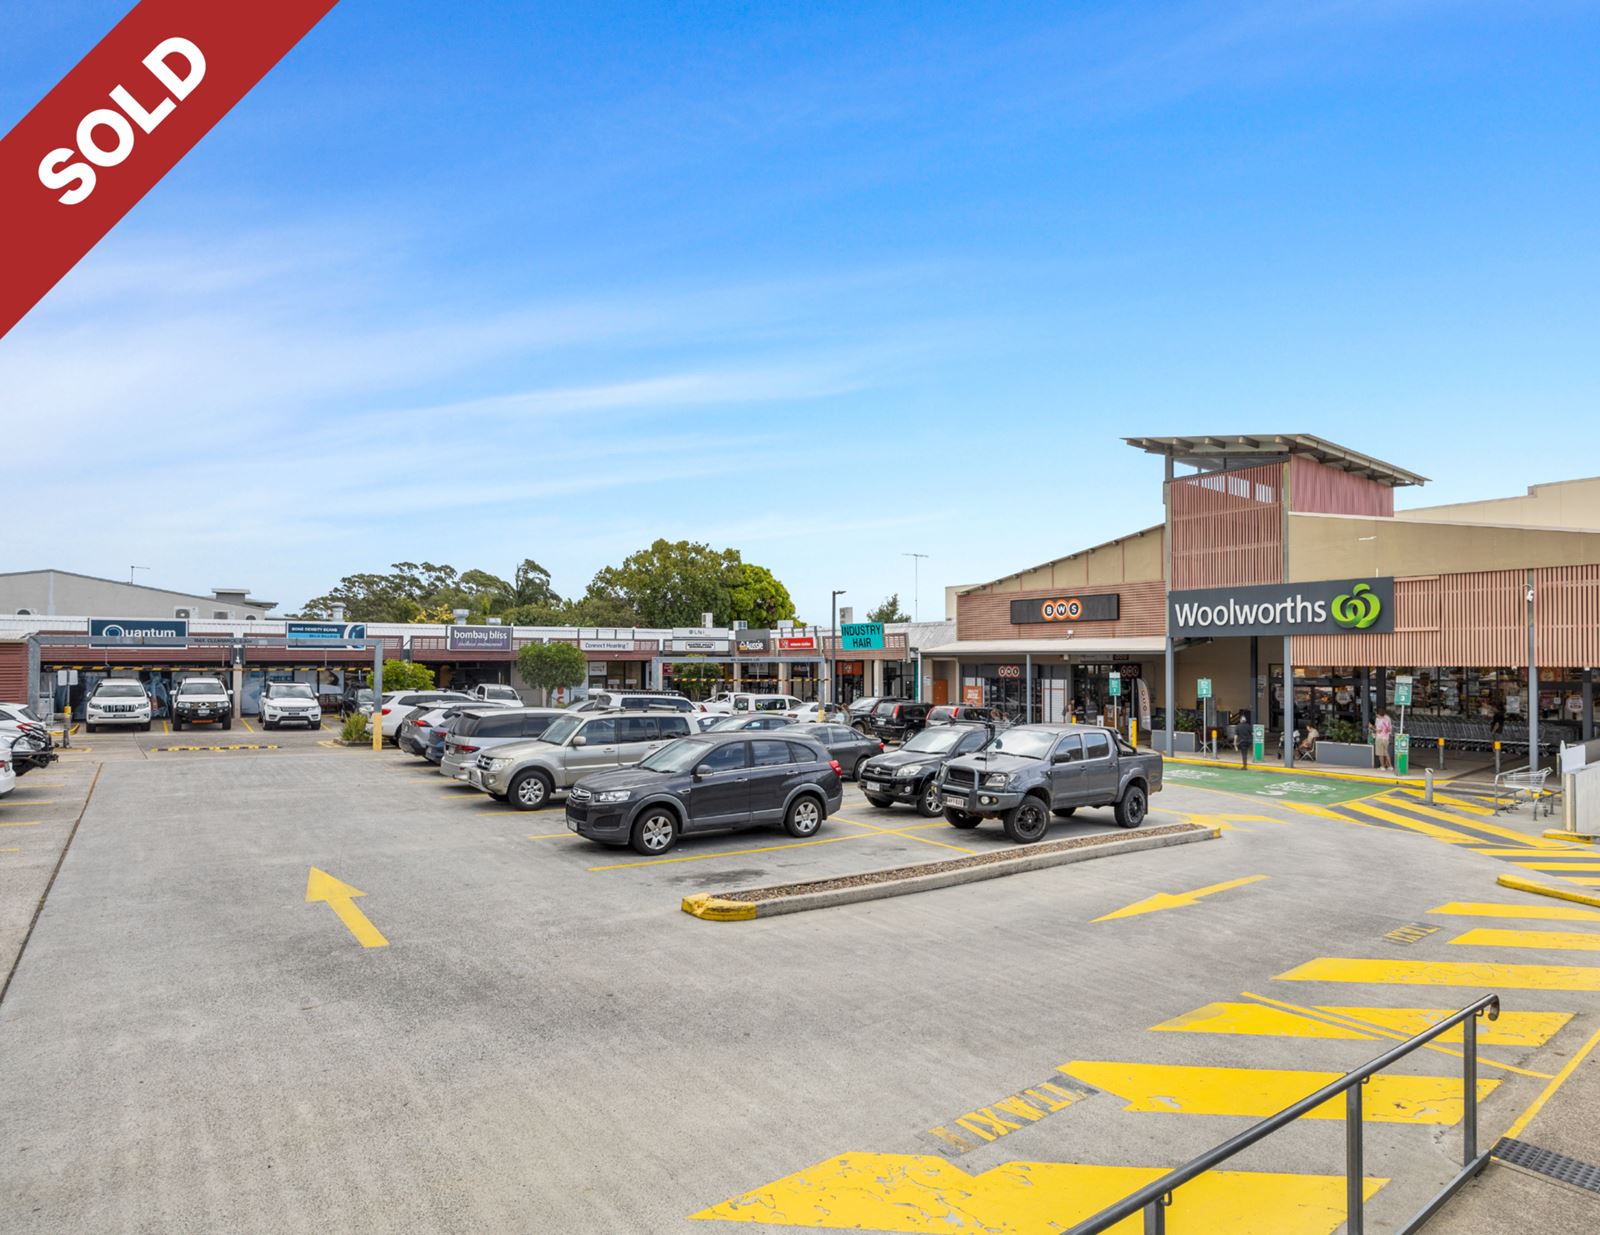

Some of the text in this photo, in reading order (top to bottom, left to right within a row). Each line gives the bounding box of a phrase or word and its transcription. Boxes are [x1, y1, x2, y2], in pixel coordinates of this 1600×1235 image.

[1175, 594, 1327, 627] Woolworths
[102, 624, 176, 638] Quantum
[454, 630, 507, 641] bombay bliss
[841, 624, 881, 636] INDUSTRY
[852, 638, 872, 648] HAIR
